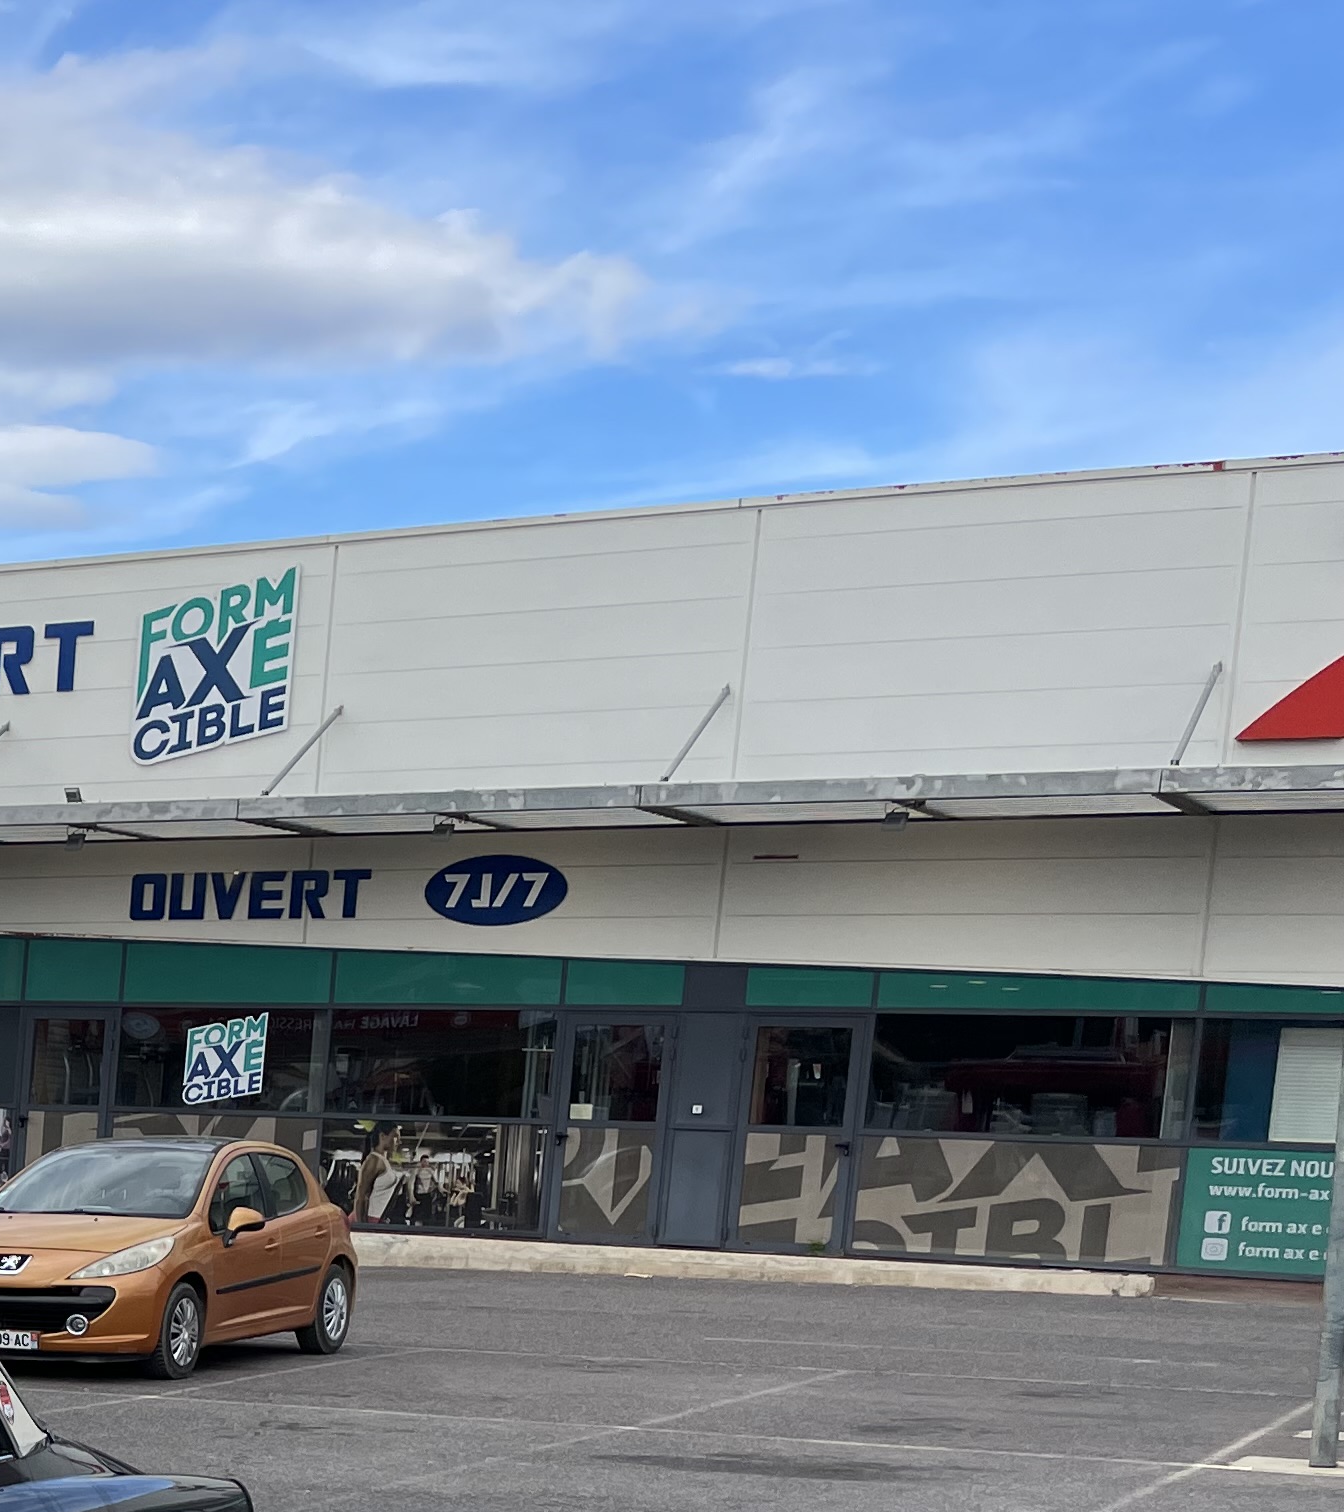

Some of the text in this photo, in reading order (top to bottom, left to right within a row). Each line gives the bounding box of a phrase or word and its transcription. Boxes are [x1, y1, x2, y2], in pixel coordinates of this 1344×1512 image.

[136, 566, 297, 702] FORM
[133, 685, 287, 760] CIBLE
[129, 868, 373, 922] OUVERT
[186, 1015, 267, 1075] FORM
[184, 1072, 262, 1103] CIBLE
[1210, 1156, 1334, 1179] SUIVEZ NOU
[1208, 1183, 1331, 1201] www.form-ax
[1240, 1216, 1283, 1234] form
[1237, 1241, 1281, 1259] form
